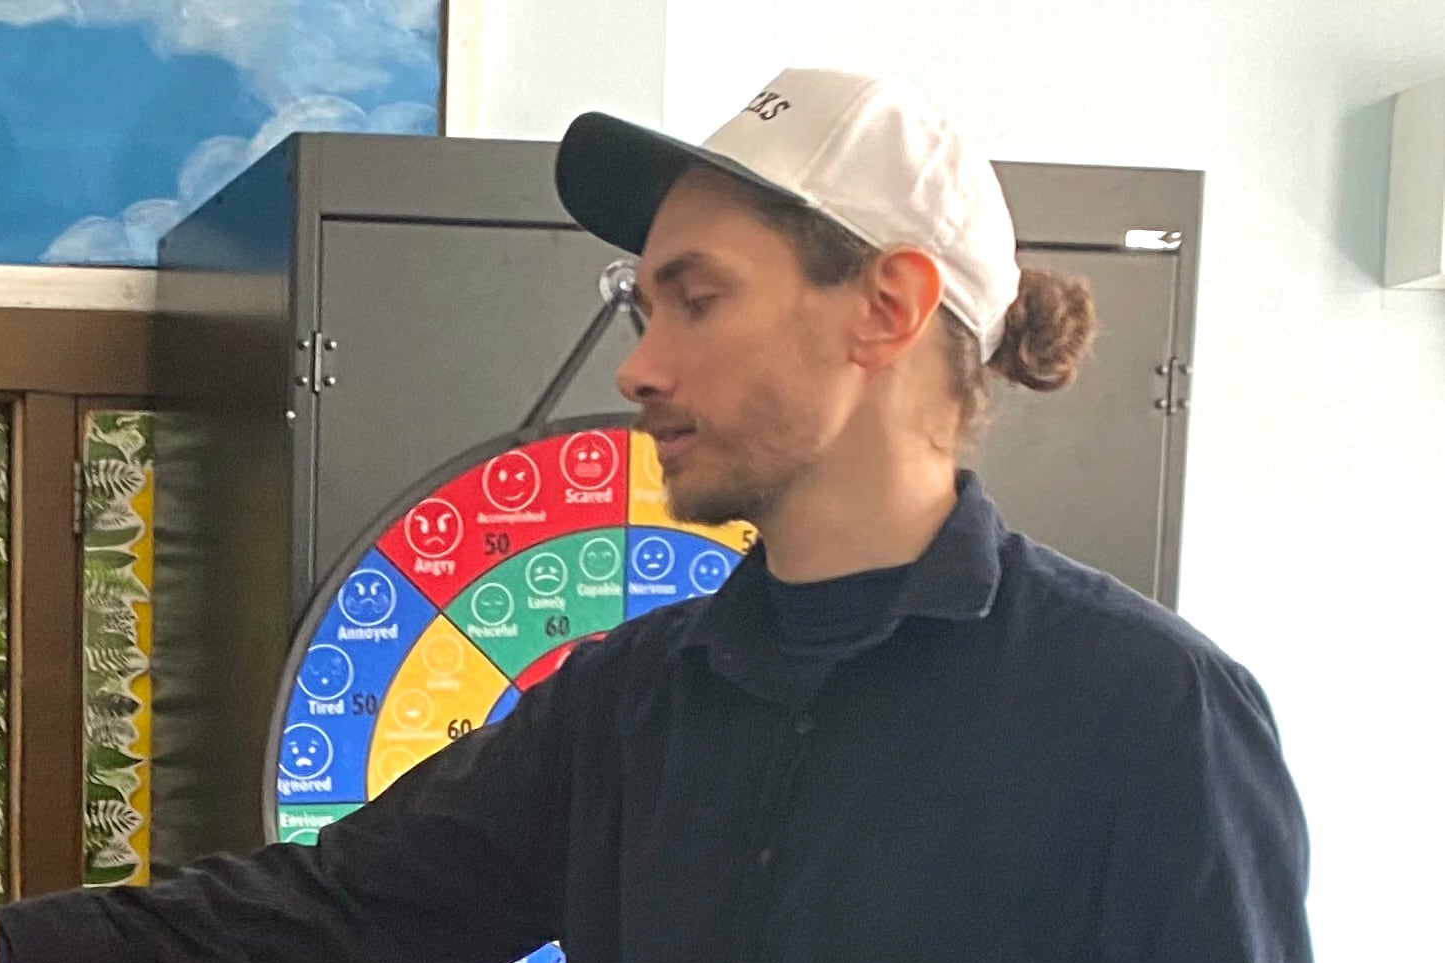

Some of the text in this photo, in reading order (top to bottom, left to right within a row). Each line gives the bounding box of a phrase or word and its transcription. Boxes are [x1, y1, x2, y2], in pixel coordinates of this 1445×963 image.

[565, 488, 613, 504] Scared
[484, 533, 510, 555] 50
[414, 557, 456, 576] Angry
[628, 583, 677, 596] Nervous
[338, 624, 399, 643] Annoyed
[466, 622, 519, 639] Peaceful
[545, 615, 571, 637] 60
[308, 699, 345, 716] Tired
[352, 693, 378, 716] 50
[447, 719, 472, 741] 60
[278, 776, 332, 796] Ignored
